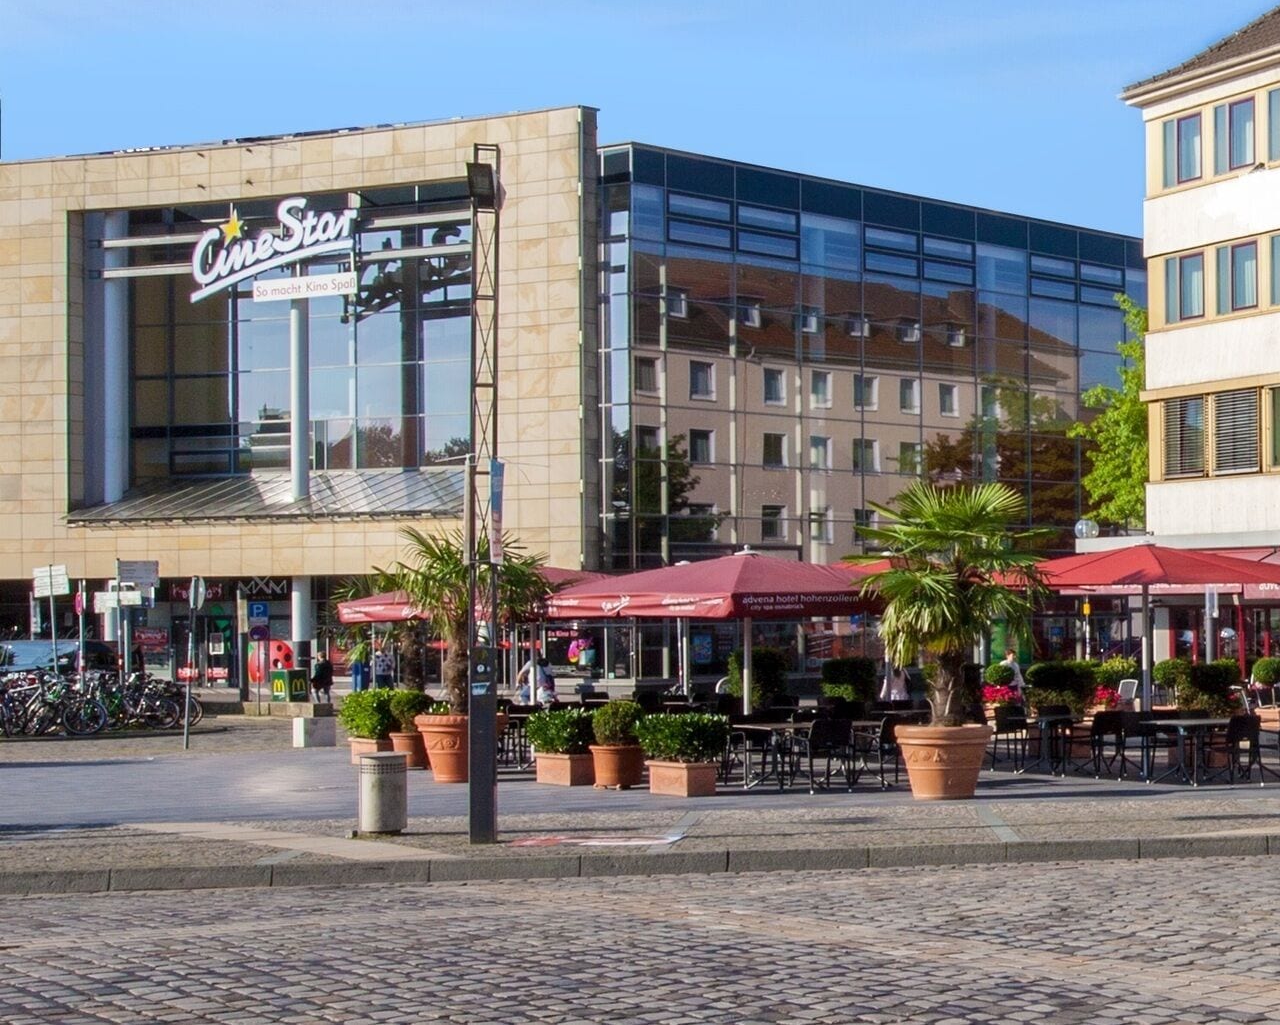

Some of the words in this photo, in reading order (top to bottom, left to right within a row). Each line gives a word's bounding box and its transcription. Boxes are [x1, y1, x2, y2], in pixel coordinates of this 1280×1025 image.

[192, 196, 358, 285] CineStar
[256, 285, 268, 297] So
[271, 280, 301, 295] macht
[305, 280, 328, 293] Kino
[331, 277, 356, 291] Spaß
[743, 595, 774, 604] advena
[776, 595, 799, 603] hotel
[800, 594, 859, 603] hohenzollern
